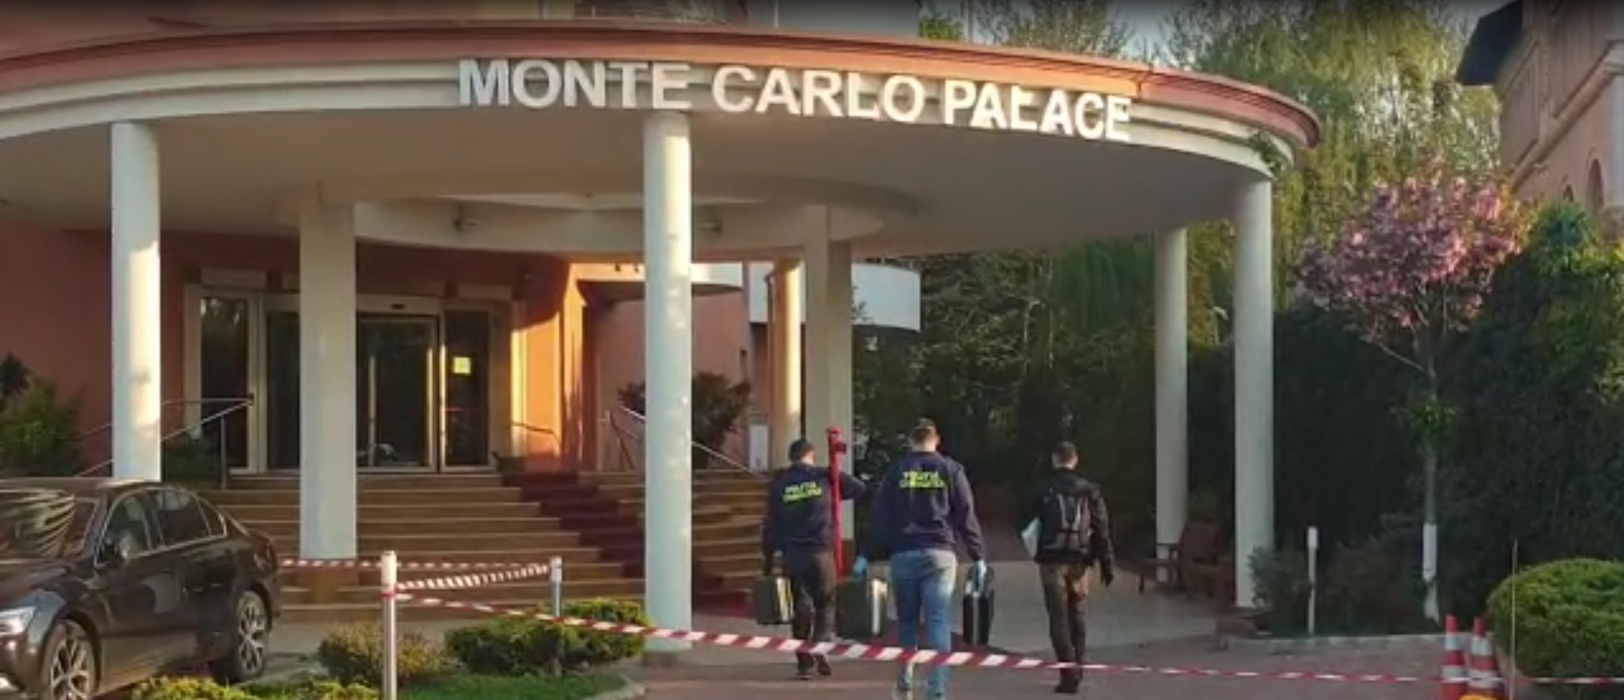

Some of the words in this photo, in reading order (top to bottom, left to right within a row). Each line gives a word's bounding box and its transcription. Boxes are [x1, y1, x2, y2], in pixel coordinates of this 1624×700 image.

[458, 58, 692, 108] MONTE
[711, 65, 925, 123] CARLO
[944, 79, 1132, 142] PALACE
